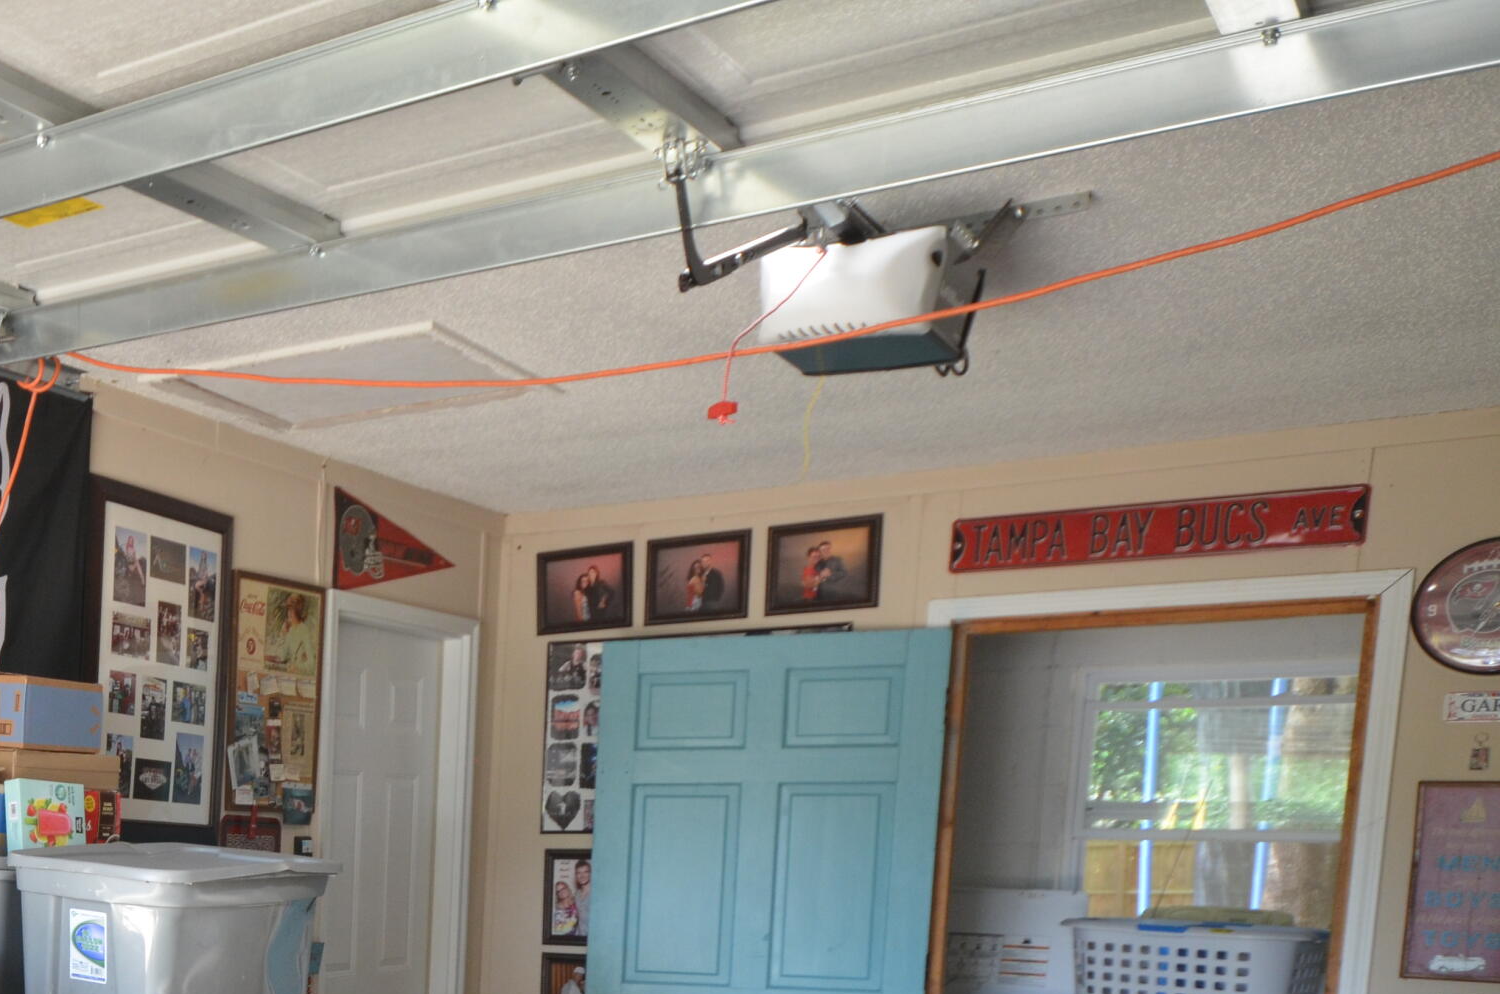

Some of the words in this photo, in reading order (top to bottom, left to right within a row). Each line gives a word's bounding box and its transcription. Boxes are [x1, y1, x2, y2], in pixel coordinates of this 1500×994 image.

[972, 519, 1069, 564] TAMPA
[1089, 509, 1157, 556] BAY
[1174, 499, 1270, 552] BUCS
[1291, 504, 1346, 533] AVE
[1427, 604, 1438, 617] 9
